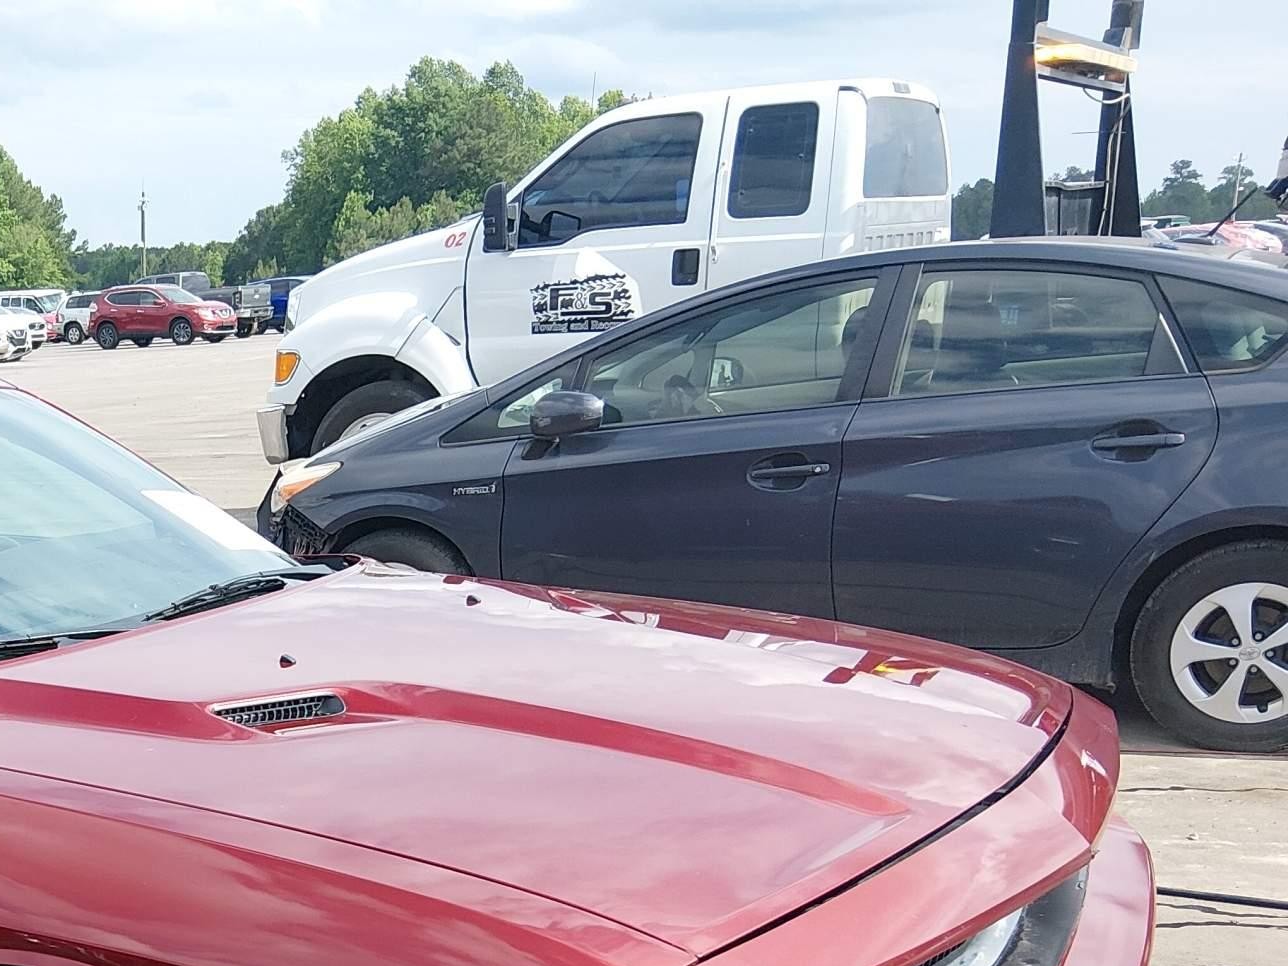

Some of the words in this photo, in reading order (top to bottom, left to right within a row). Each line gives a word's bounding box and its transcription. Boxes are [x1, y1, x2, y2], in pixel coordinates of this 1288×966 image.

[444, 231, 467, 248] 02
[532, 321, 569, 333] Towing
[570, 320, 589, 330] and
